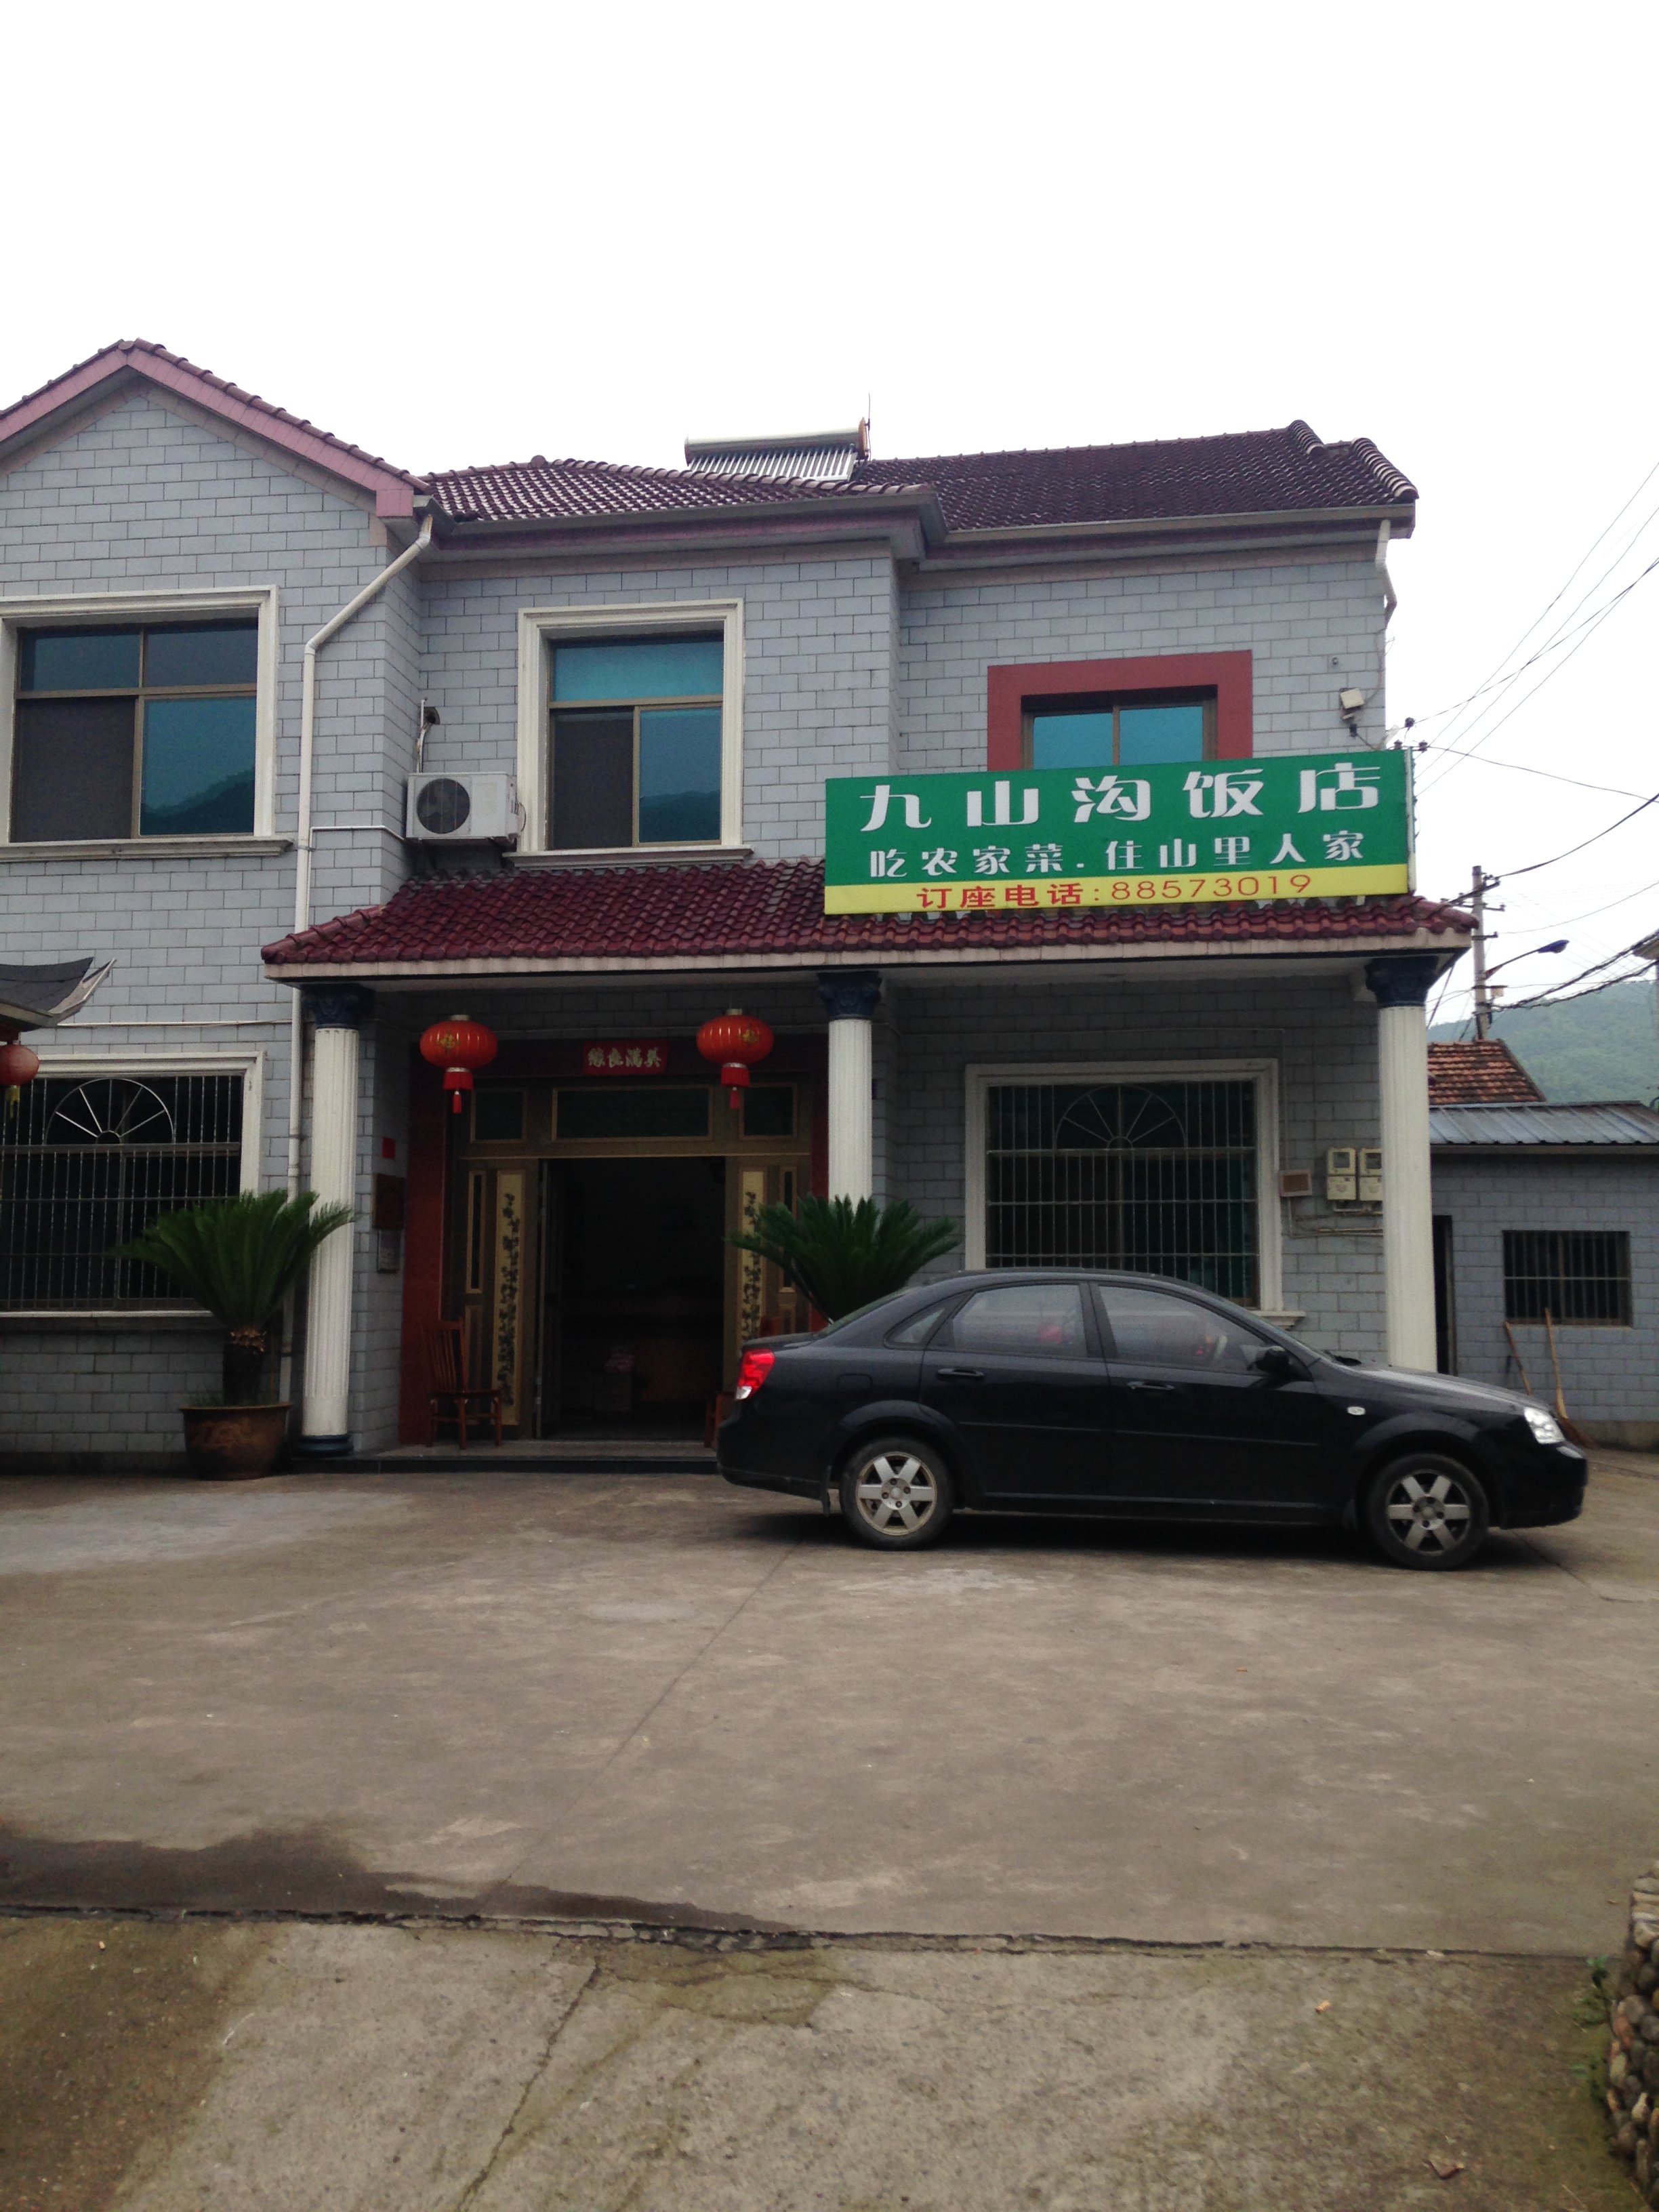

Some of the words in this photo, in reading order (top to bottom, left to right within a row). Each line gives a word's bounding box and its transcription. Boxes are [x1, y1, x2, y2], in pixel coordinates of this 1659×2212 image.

[860, 761, 1380, 832] 九山沟饭店
